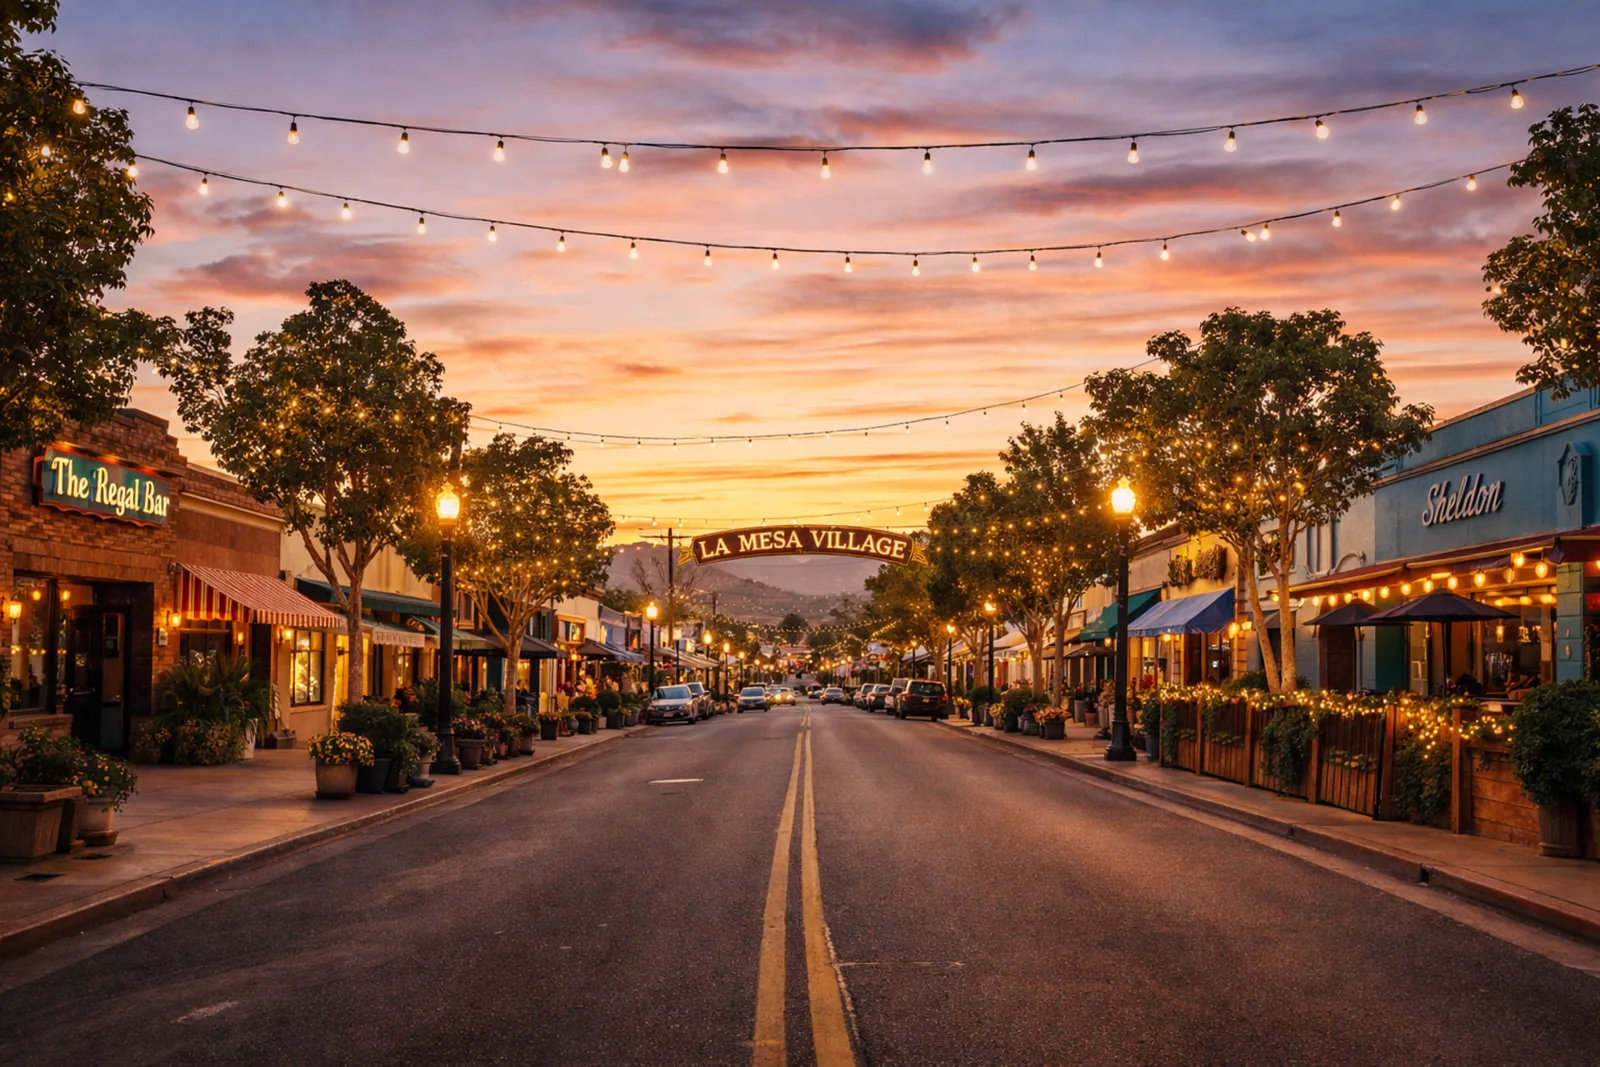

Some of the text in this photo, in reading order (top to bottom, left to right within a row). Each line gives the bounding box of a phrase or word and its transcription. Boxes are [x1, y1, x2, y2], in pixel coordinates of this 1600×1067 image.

[51, 457, 171, 517] The Regal Bar
[1422, 472, 1502, 527] Sheldon
[699, 530, 907, 560] LA MESA VILLAGE
